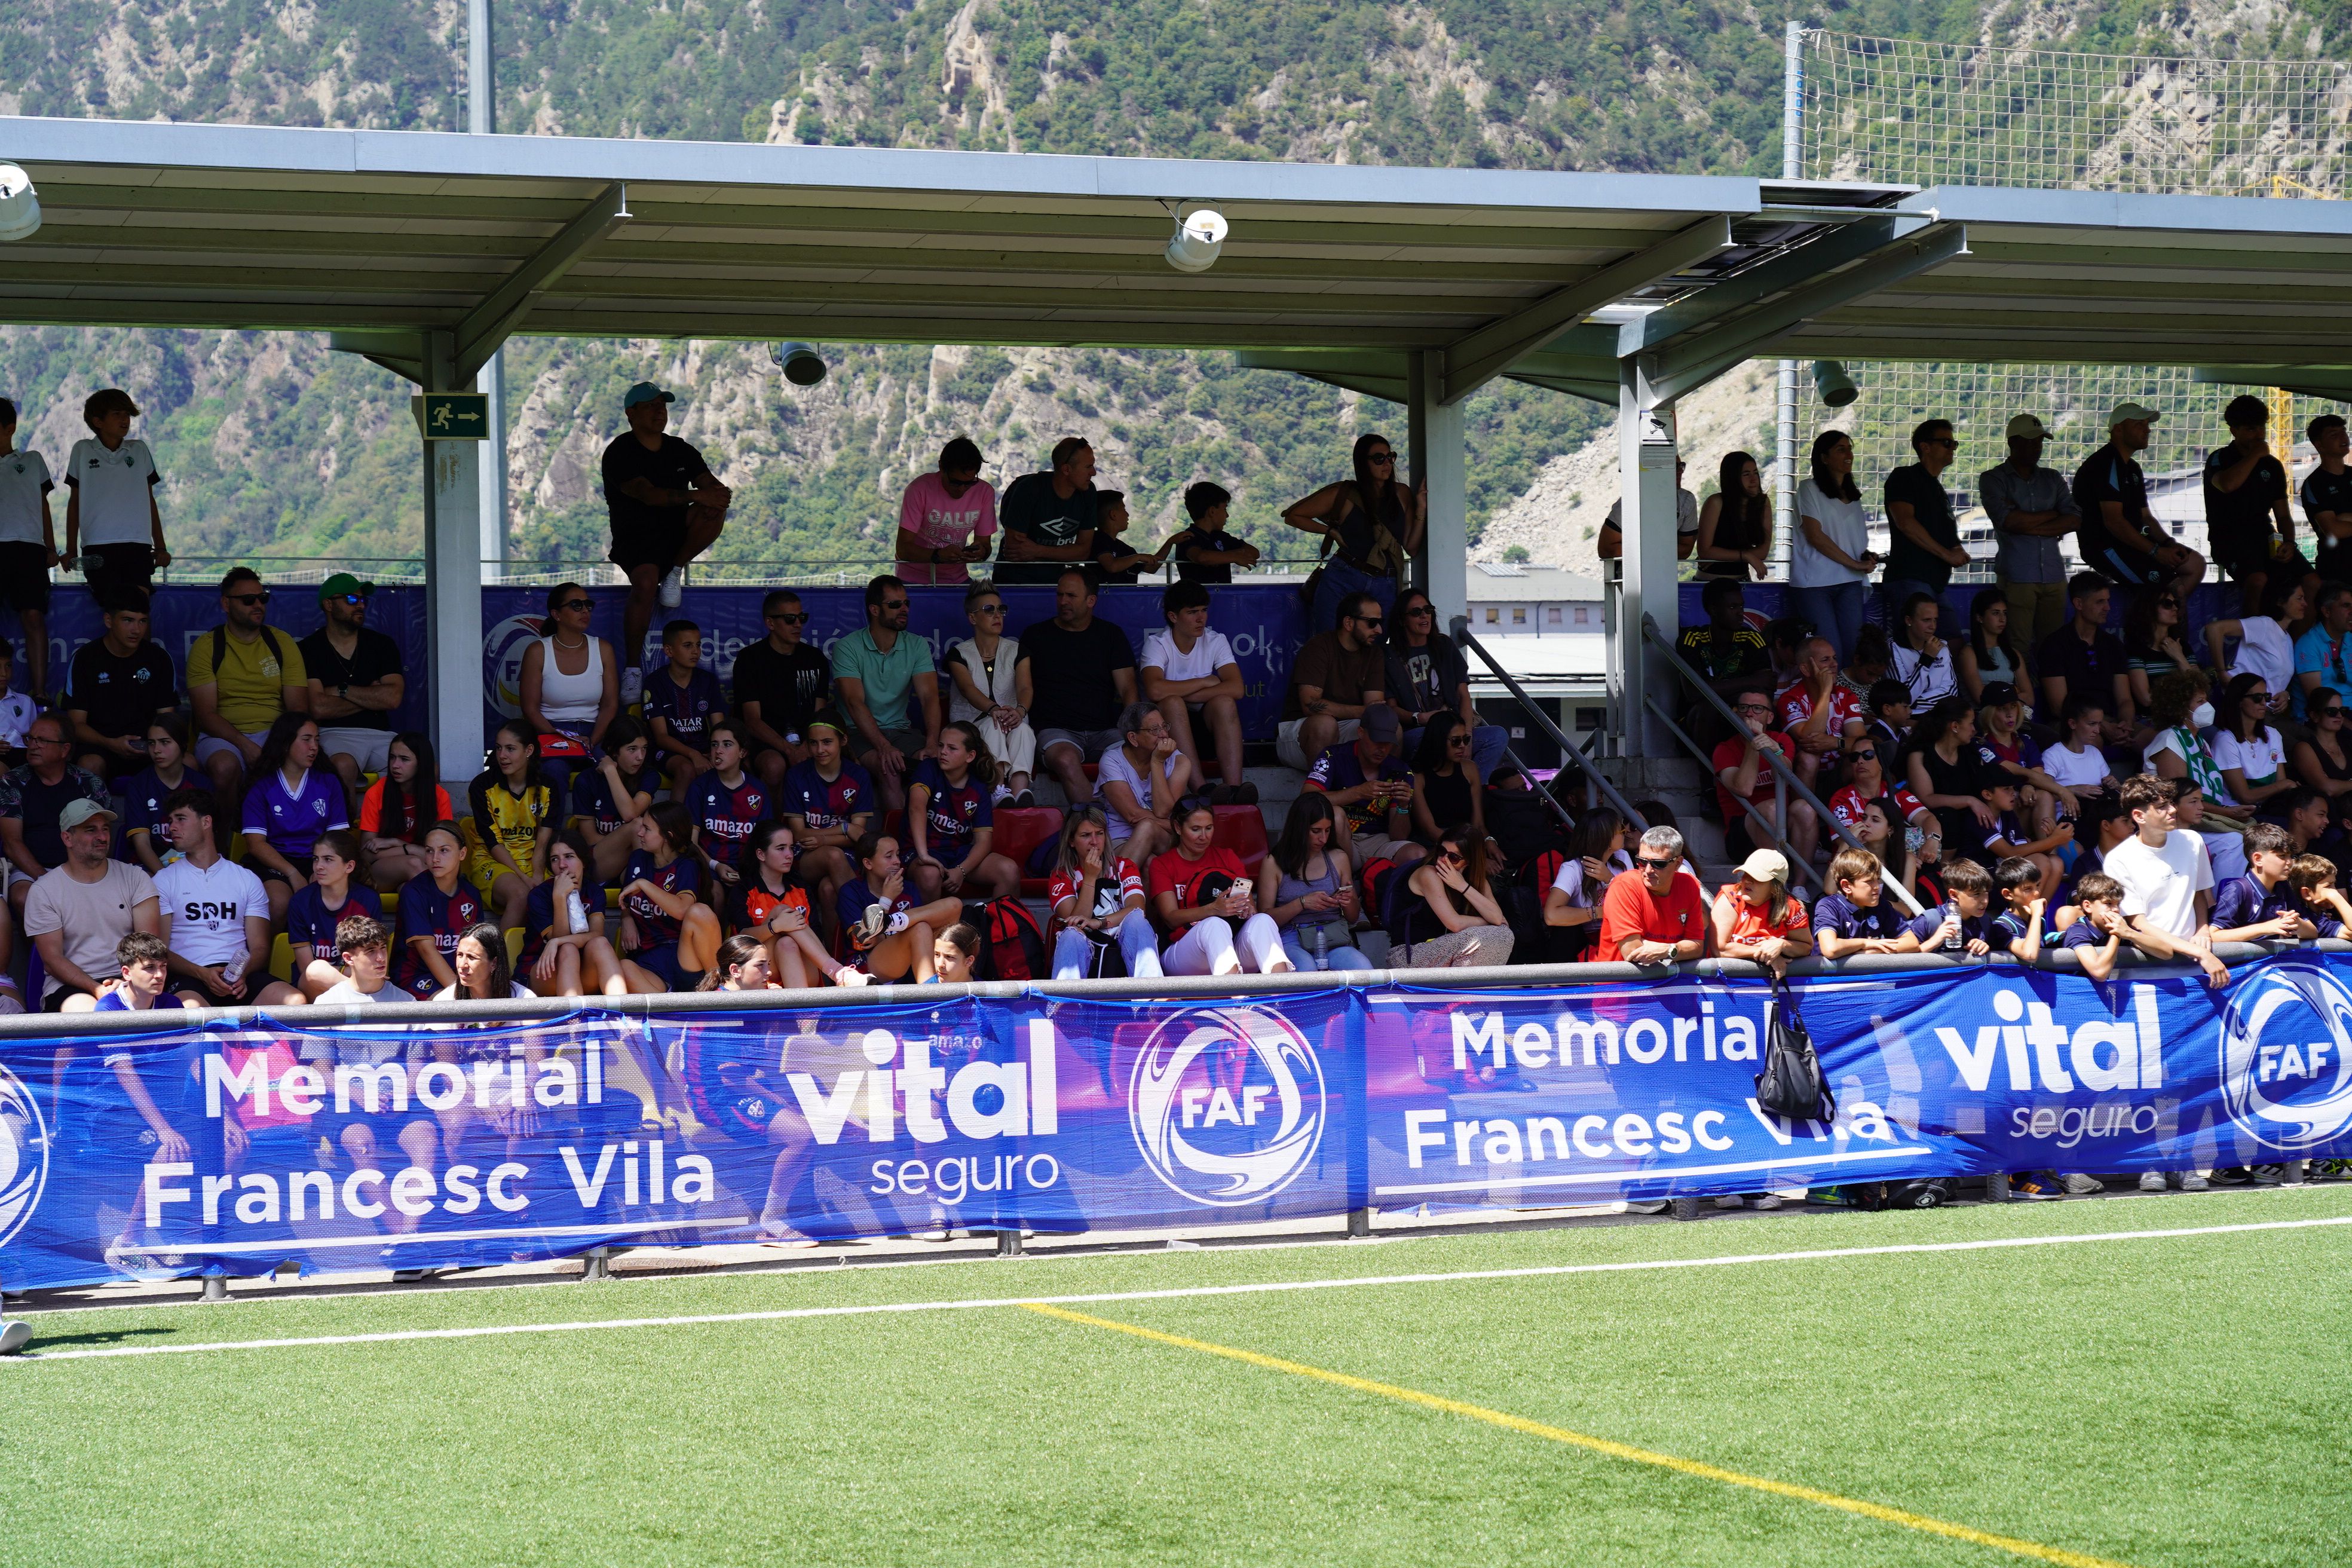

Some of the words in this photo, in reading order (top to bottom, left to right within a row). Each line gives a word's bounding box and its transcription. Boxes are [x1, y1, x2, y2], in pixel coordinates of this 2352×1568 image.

[501, 826, 537, 837] mazo
[704, 817, 757, 834] amazo
[1935, 984, 2162, 1094] vital
[2259, 1042, 2333, 1082] FAF
[204, 1040, 602, 1118] Memorial
[786, 1018, 1058, 1145] vital
[1181, 1085, 1273, 1128] FAF
[2010, 1105, 2158, 1149] seguro
[1405, 1108, 1733, 1168] Francesc
[144, 1162, 530, 1227] Francesc
[558, 1140, 714, 1208] Vila
[870, 1153, 1059, 1205] seguro
